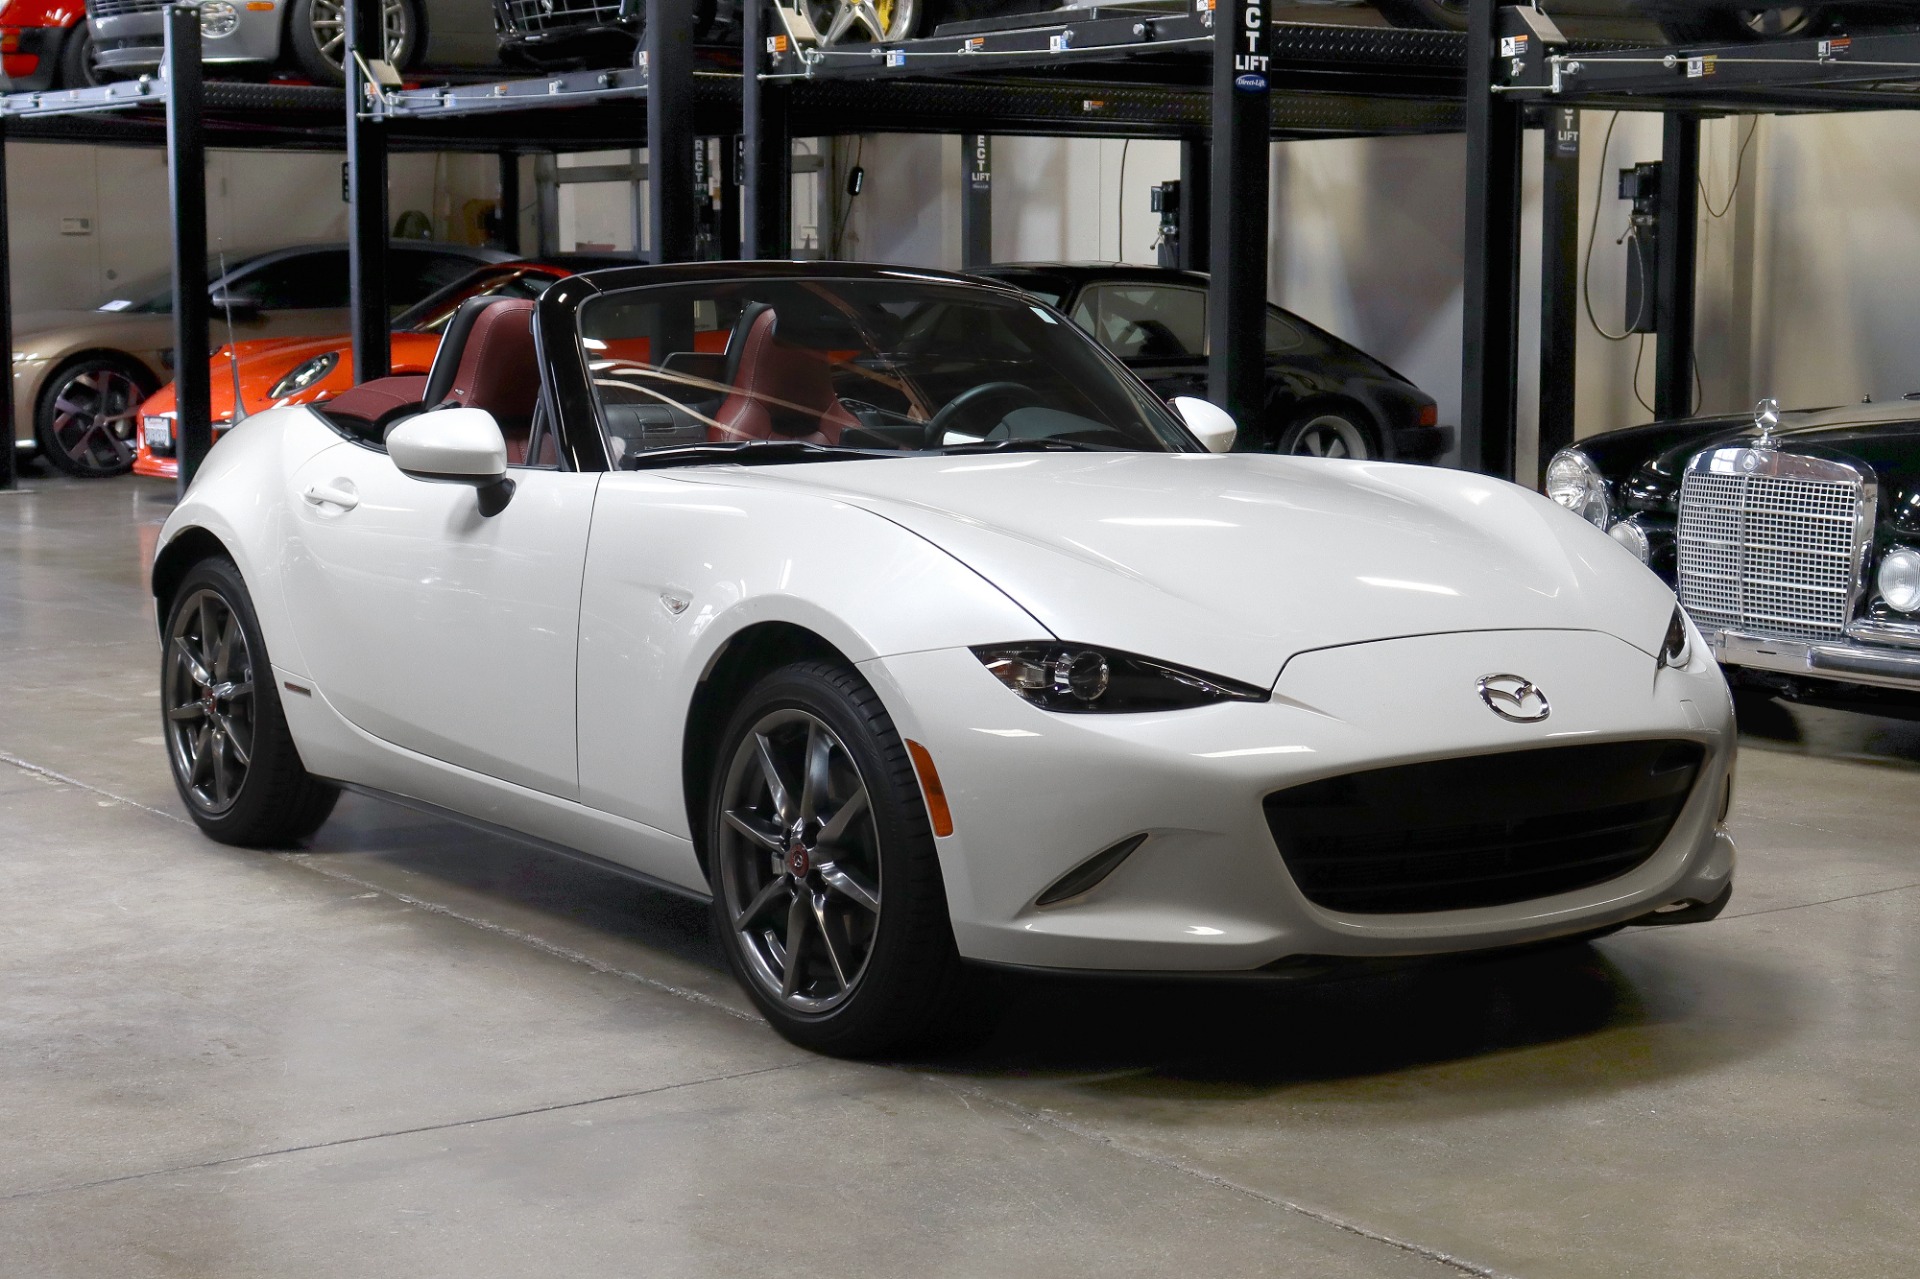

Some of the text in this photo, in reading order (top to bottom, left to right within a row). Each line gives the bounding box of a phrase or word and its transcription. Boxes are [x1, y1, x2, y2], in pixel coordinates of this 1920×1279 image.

[1245, 0, 1261, 52] CT
[1235, 54, 1269, 71] LIFT
[1558, 130, 1579, 141] LIFT
[971, 172, 990, 181] LIFT
[694, 183, 708, 191] IFT
